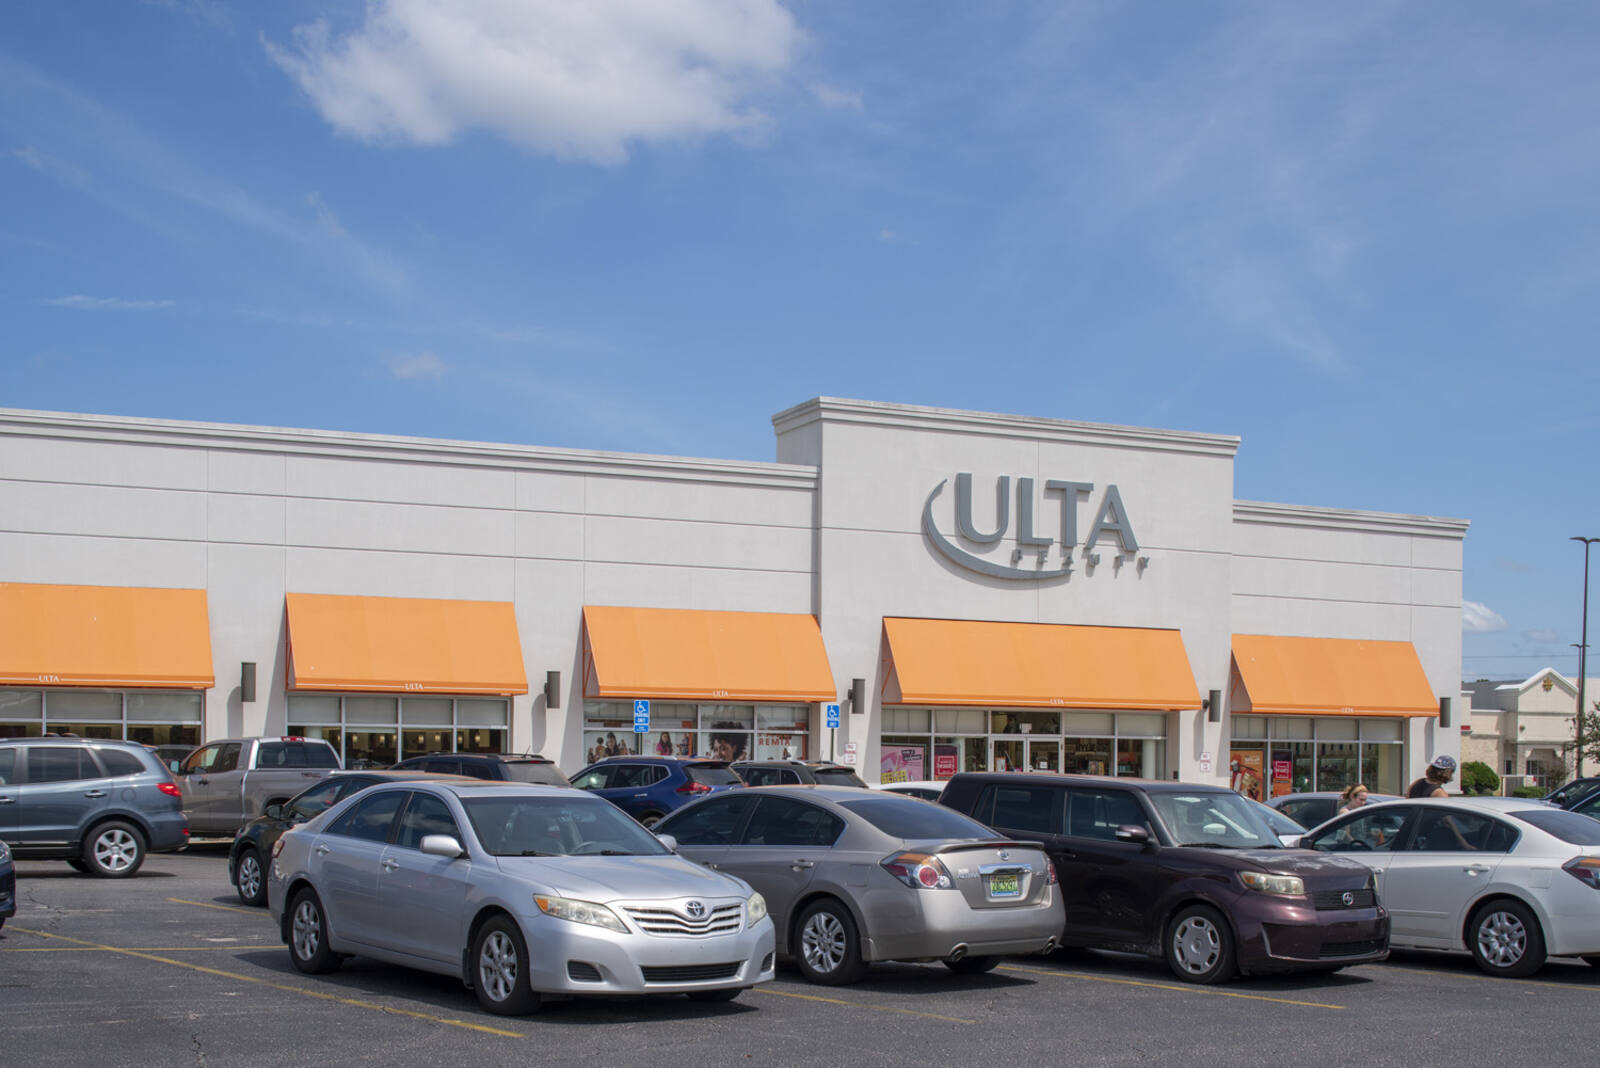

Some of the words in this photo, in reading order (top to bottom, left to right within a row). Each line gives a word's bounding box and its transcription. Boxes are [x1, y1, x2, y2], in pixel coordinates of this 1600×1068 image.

[956, 472, 1140, 552] ULTA
[1011, 549, 1150, 570] BEAUTY
[38, 674, 60, 683] ULTA
[405, 682, 424, 690] ULTA
